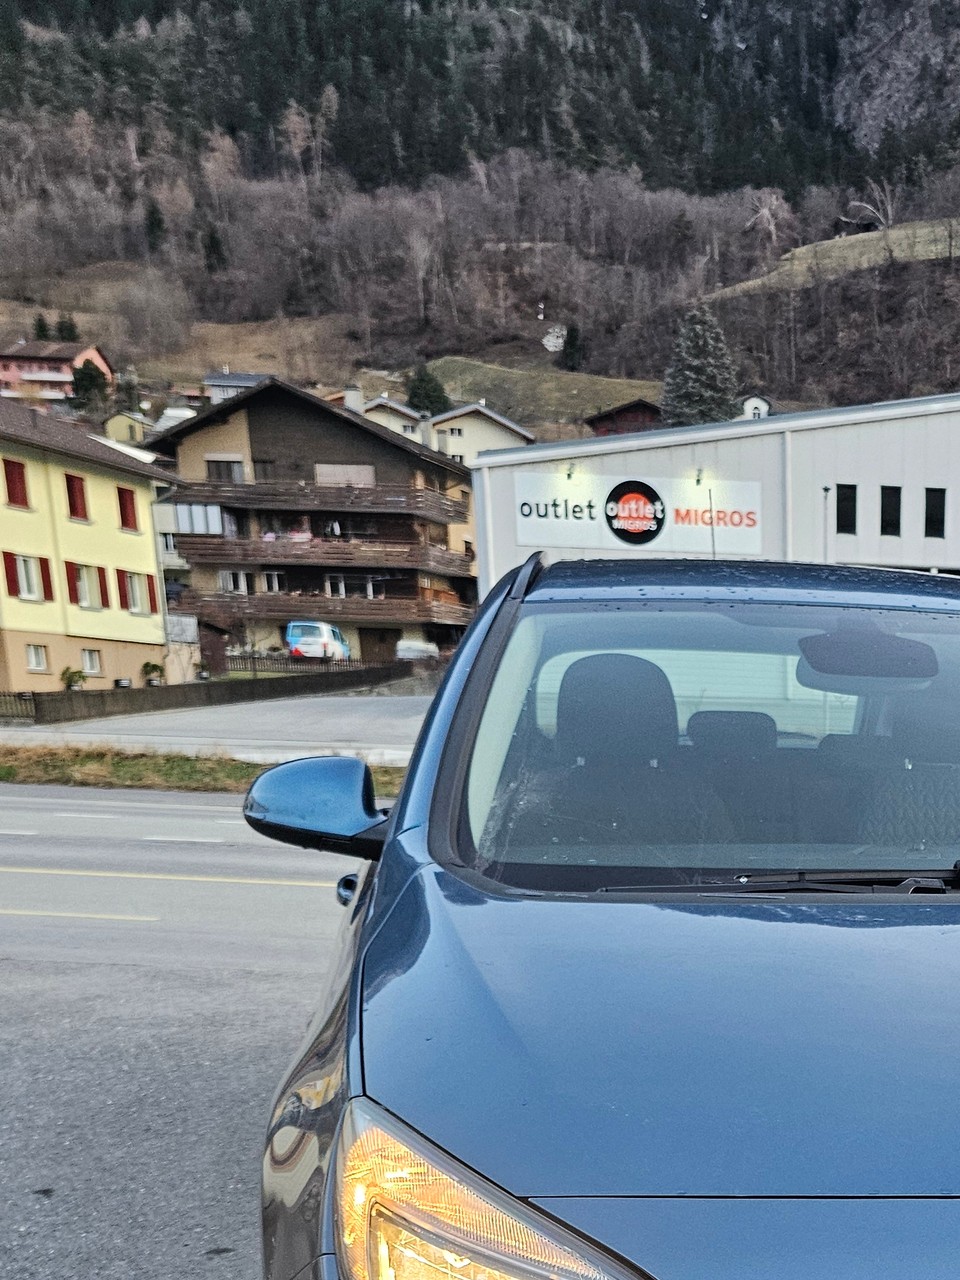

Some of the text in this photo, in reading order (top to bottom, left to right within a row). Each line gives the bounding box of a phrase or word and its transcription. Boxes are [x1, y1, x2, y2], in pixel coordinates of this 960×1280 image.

[520, 499, 597, 520] outlet
[606, 501, 665, 519] outlet
[674, 508, 757, 528] MIGROS
[613, 519, 657, 531] MIGROS
